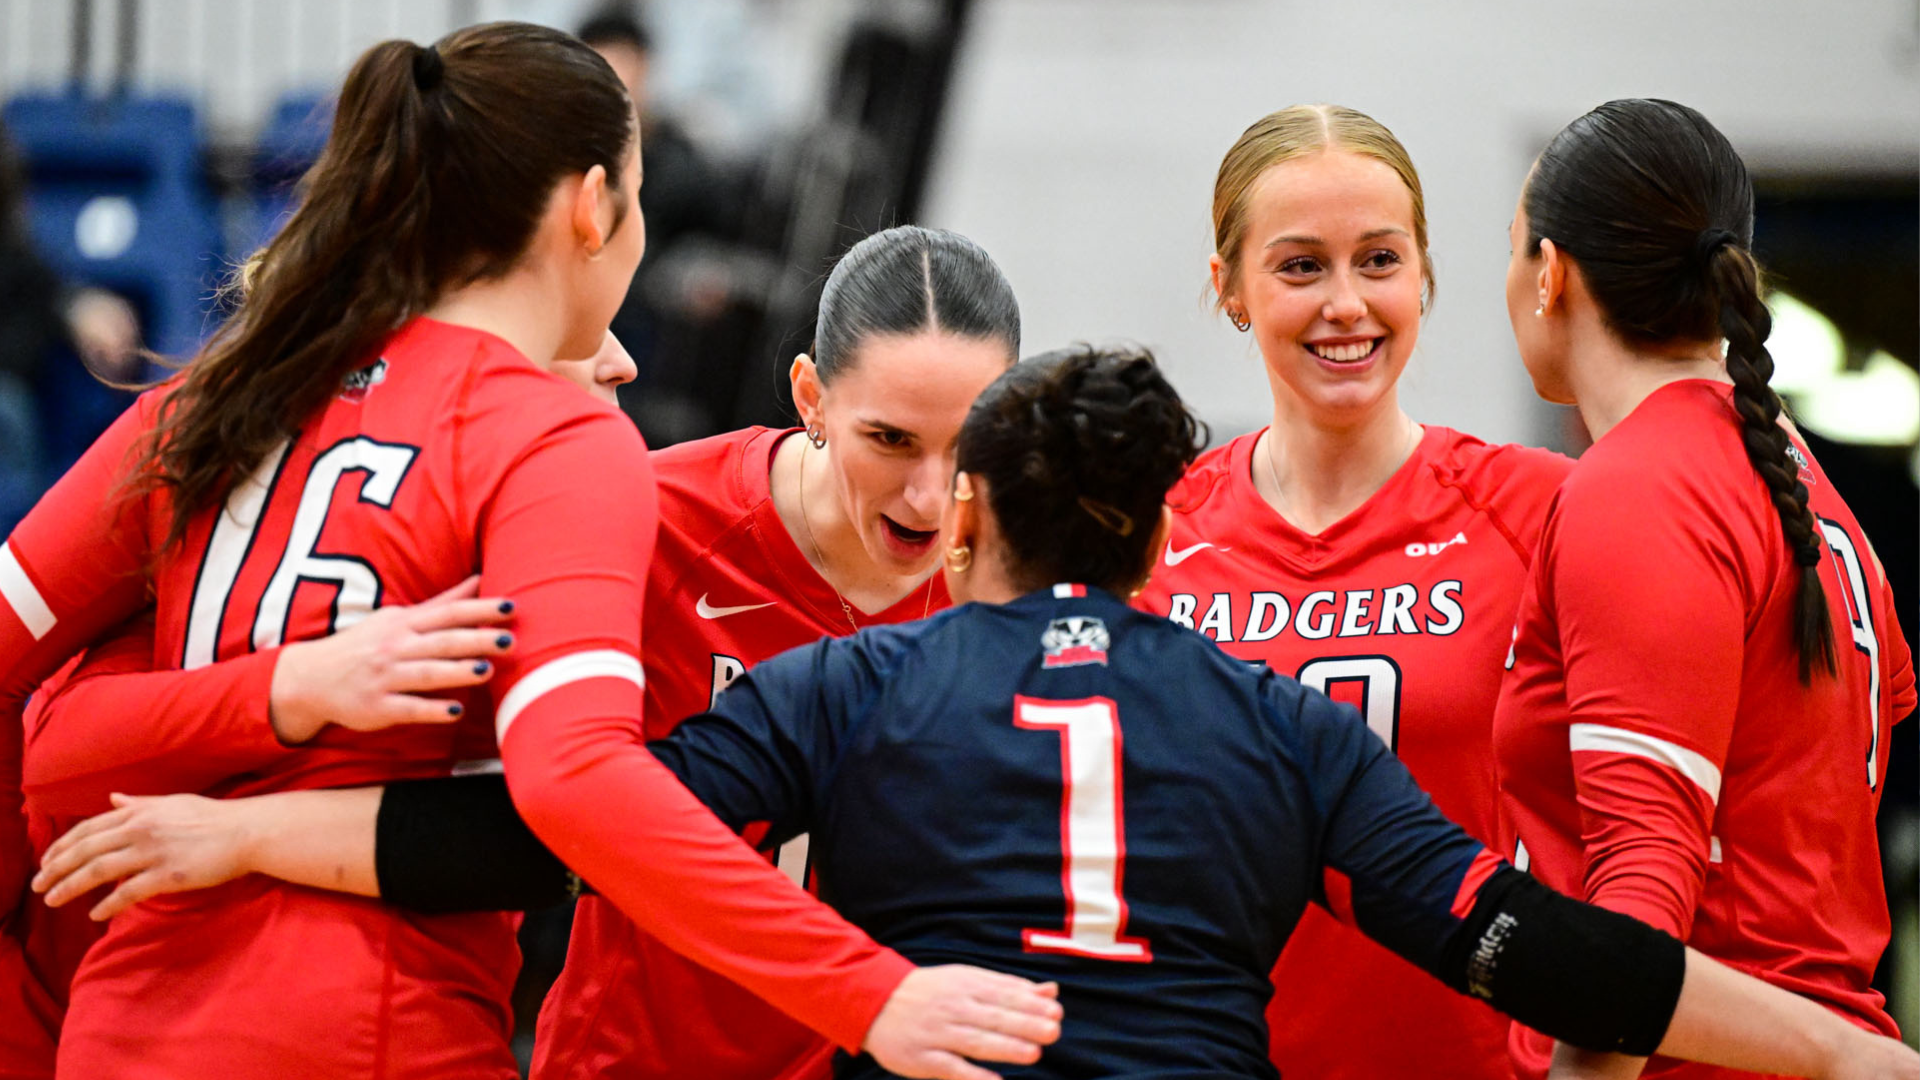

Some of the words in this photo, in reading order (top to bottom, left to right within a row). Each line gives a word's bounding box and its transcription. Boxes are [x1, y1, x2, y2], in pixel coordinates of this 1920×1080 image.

[182, 434, 422, 670] 16
[1168, 580, 1464, 642] BADGERS
[1012, 694, 1154, 964] 1
